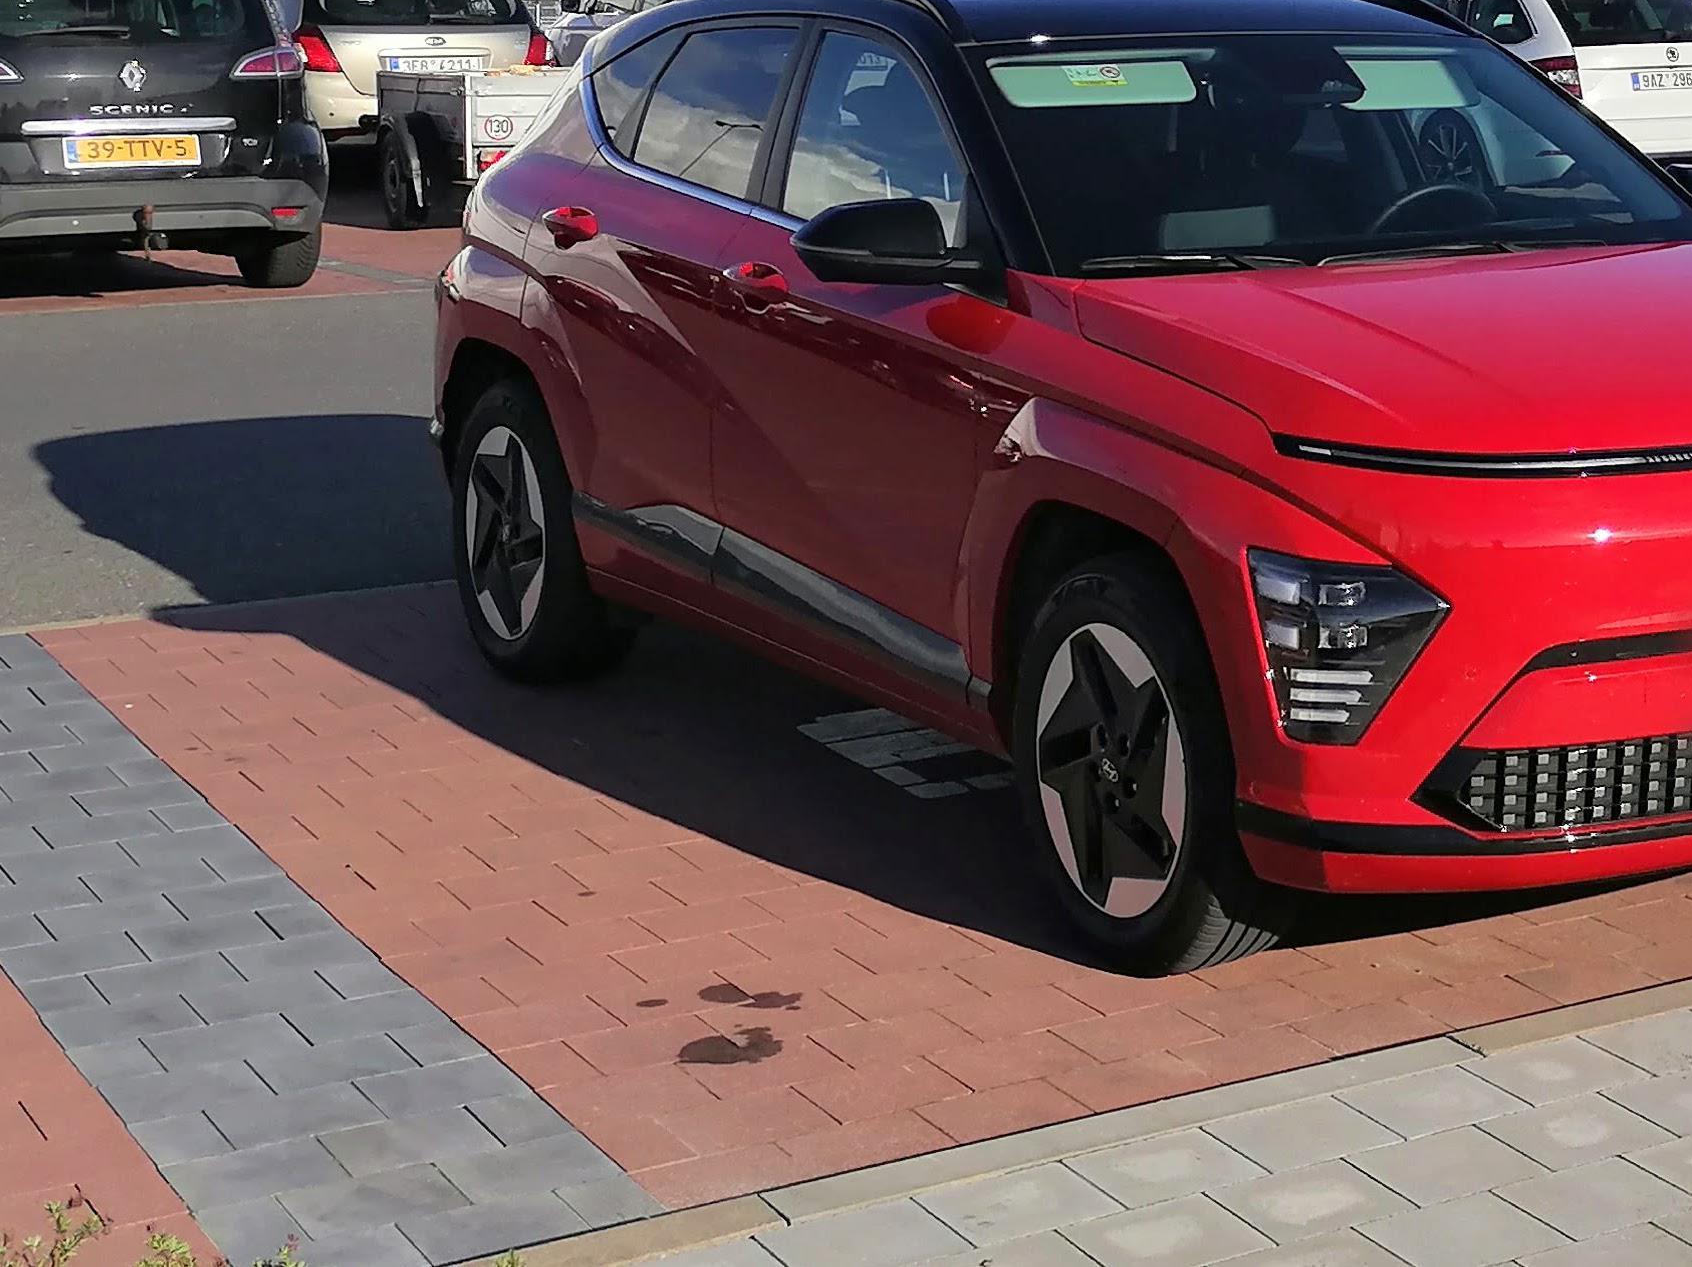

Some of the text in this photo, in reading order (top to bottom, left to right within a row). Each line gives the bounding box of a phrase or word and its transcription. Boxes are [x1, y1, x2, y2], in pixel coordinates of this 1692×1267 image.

[90, 103, 174, 116] SCENIC
[488, 119, 509, 133] 130
[87, 139, 187, 159] 39-TTV-5
